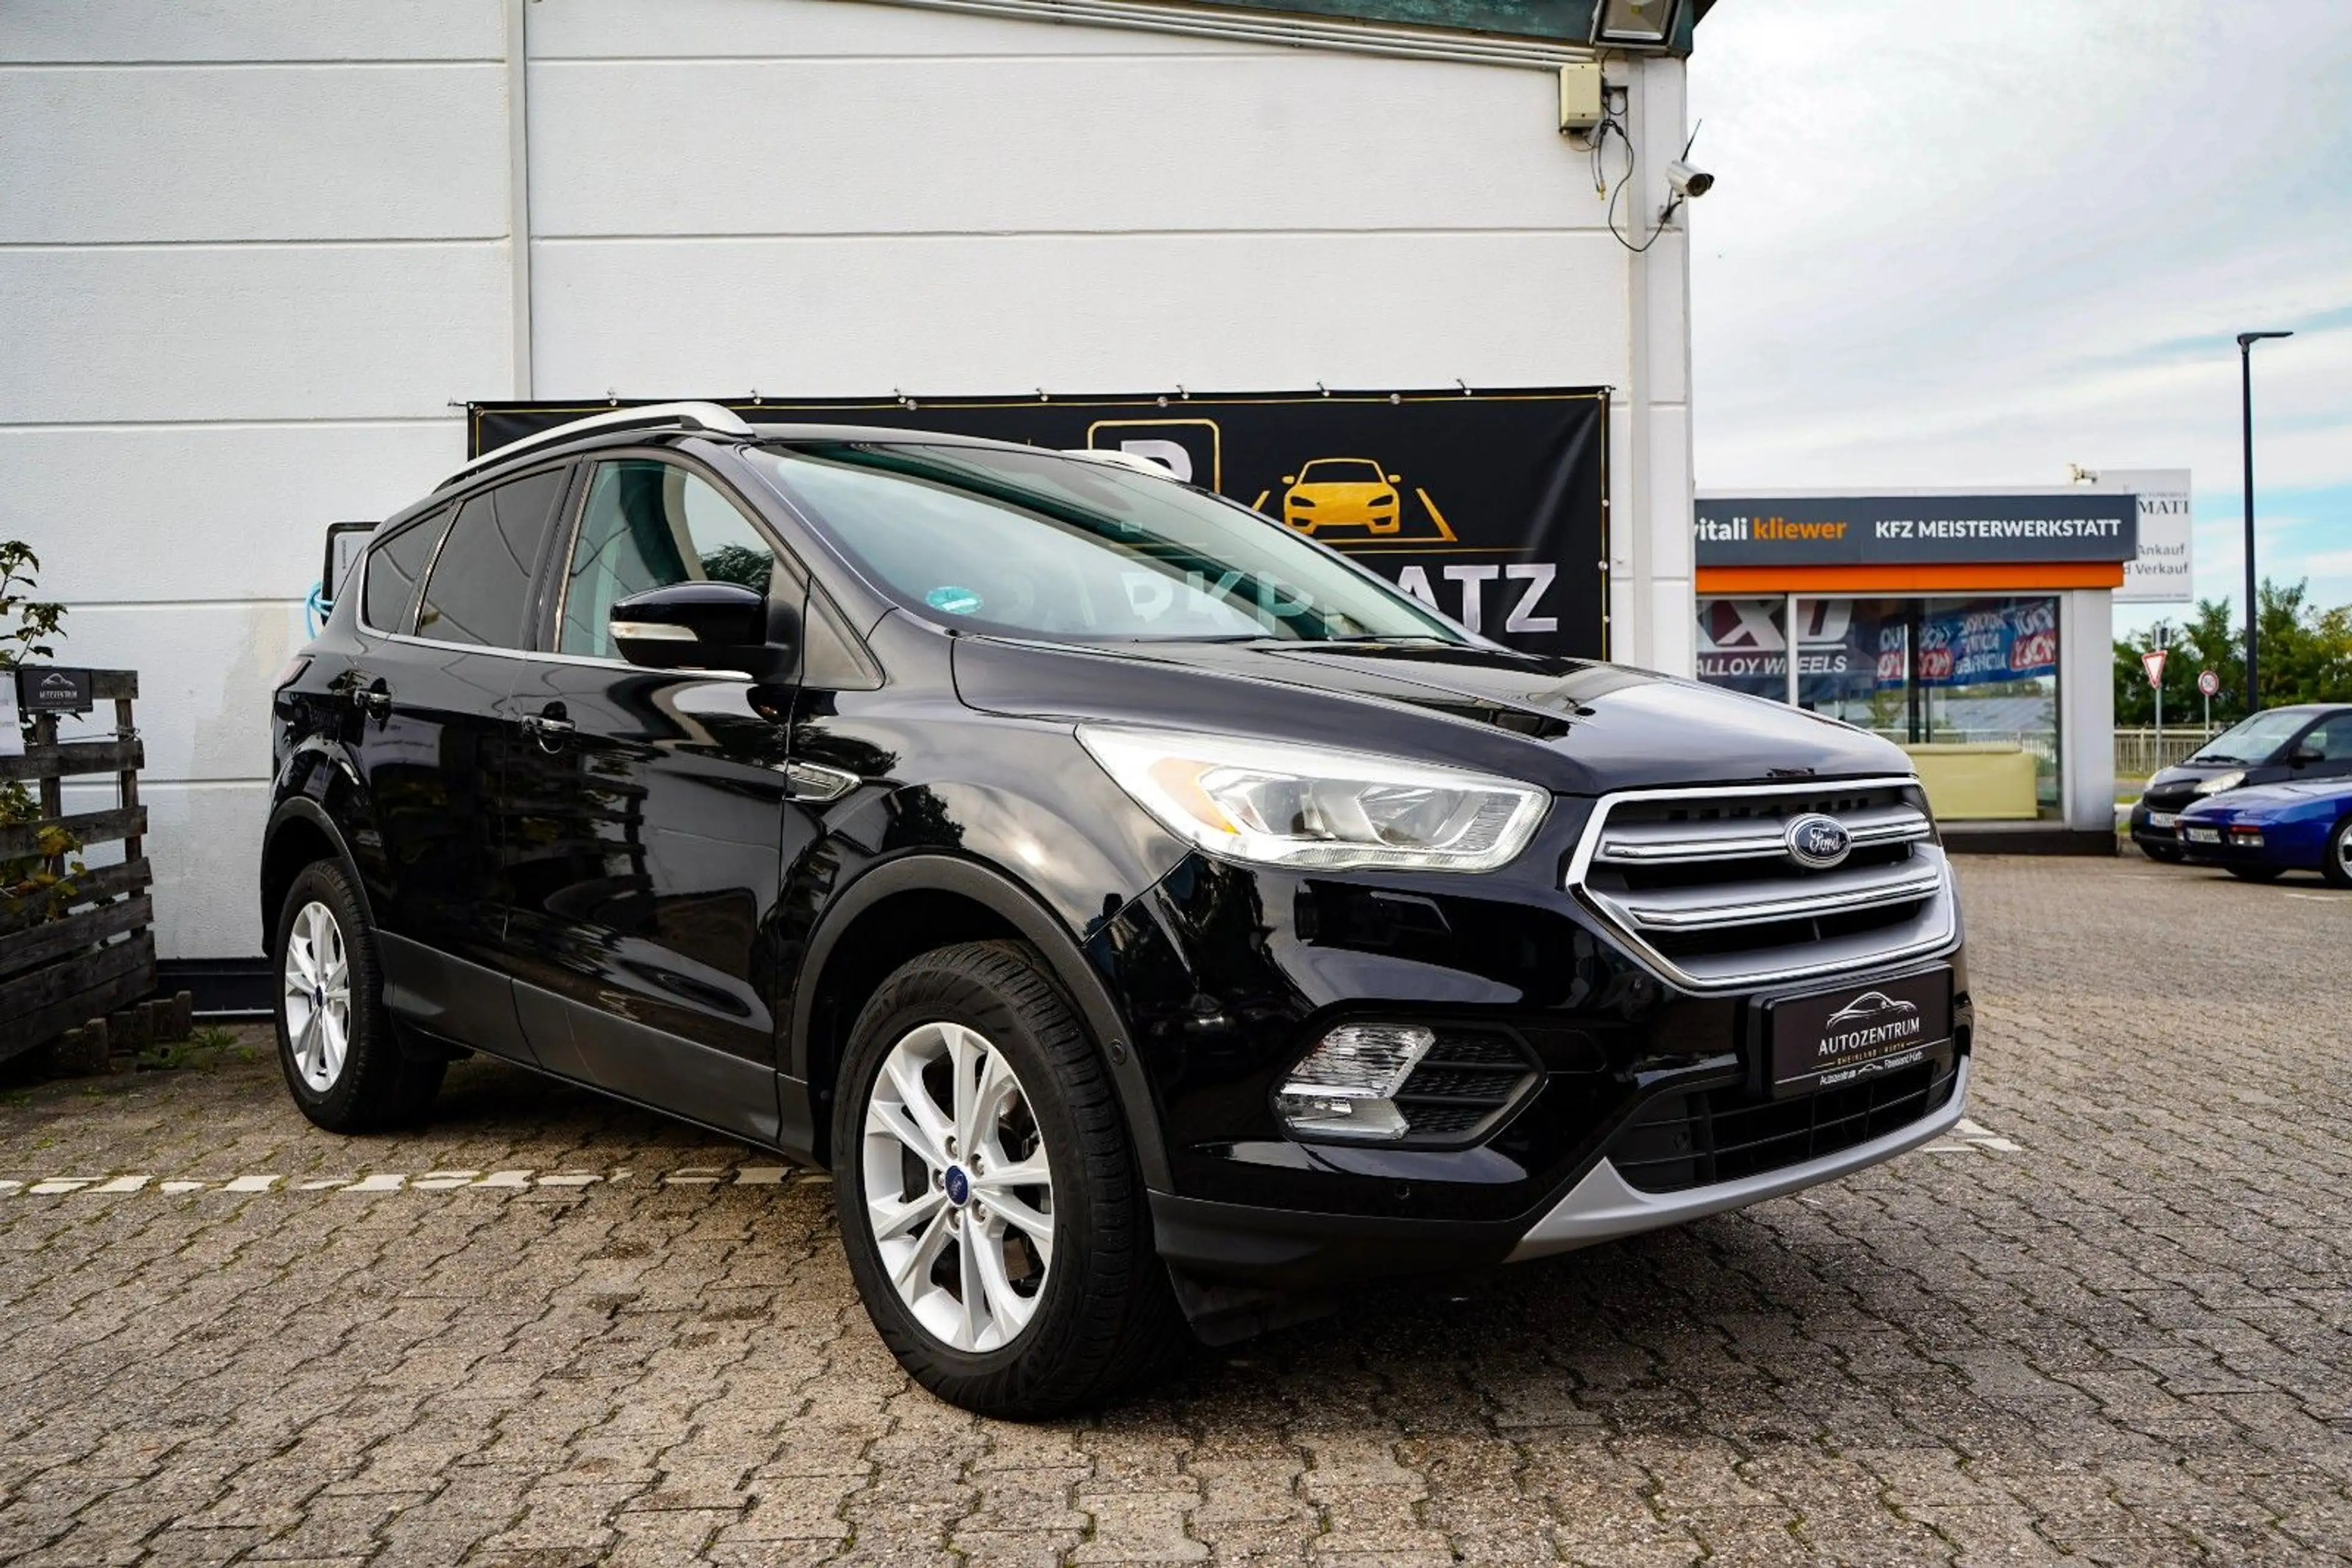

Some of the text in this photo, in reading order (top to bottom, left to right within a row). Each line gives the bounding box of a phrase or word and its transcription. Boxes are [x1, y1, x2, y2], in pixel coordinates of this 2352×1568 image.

[1754, 517, 1848, 540] kliewer
[1875, 519, 2121, 538] KFZ MEISTERWERKSTATT
[2135, 562, 2188, 575] Verkauf
[1809, 827, 1845, 853] Ford
[1818, 1016, 1920, 1056] AUTOZENTRUM
